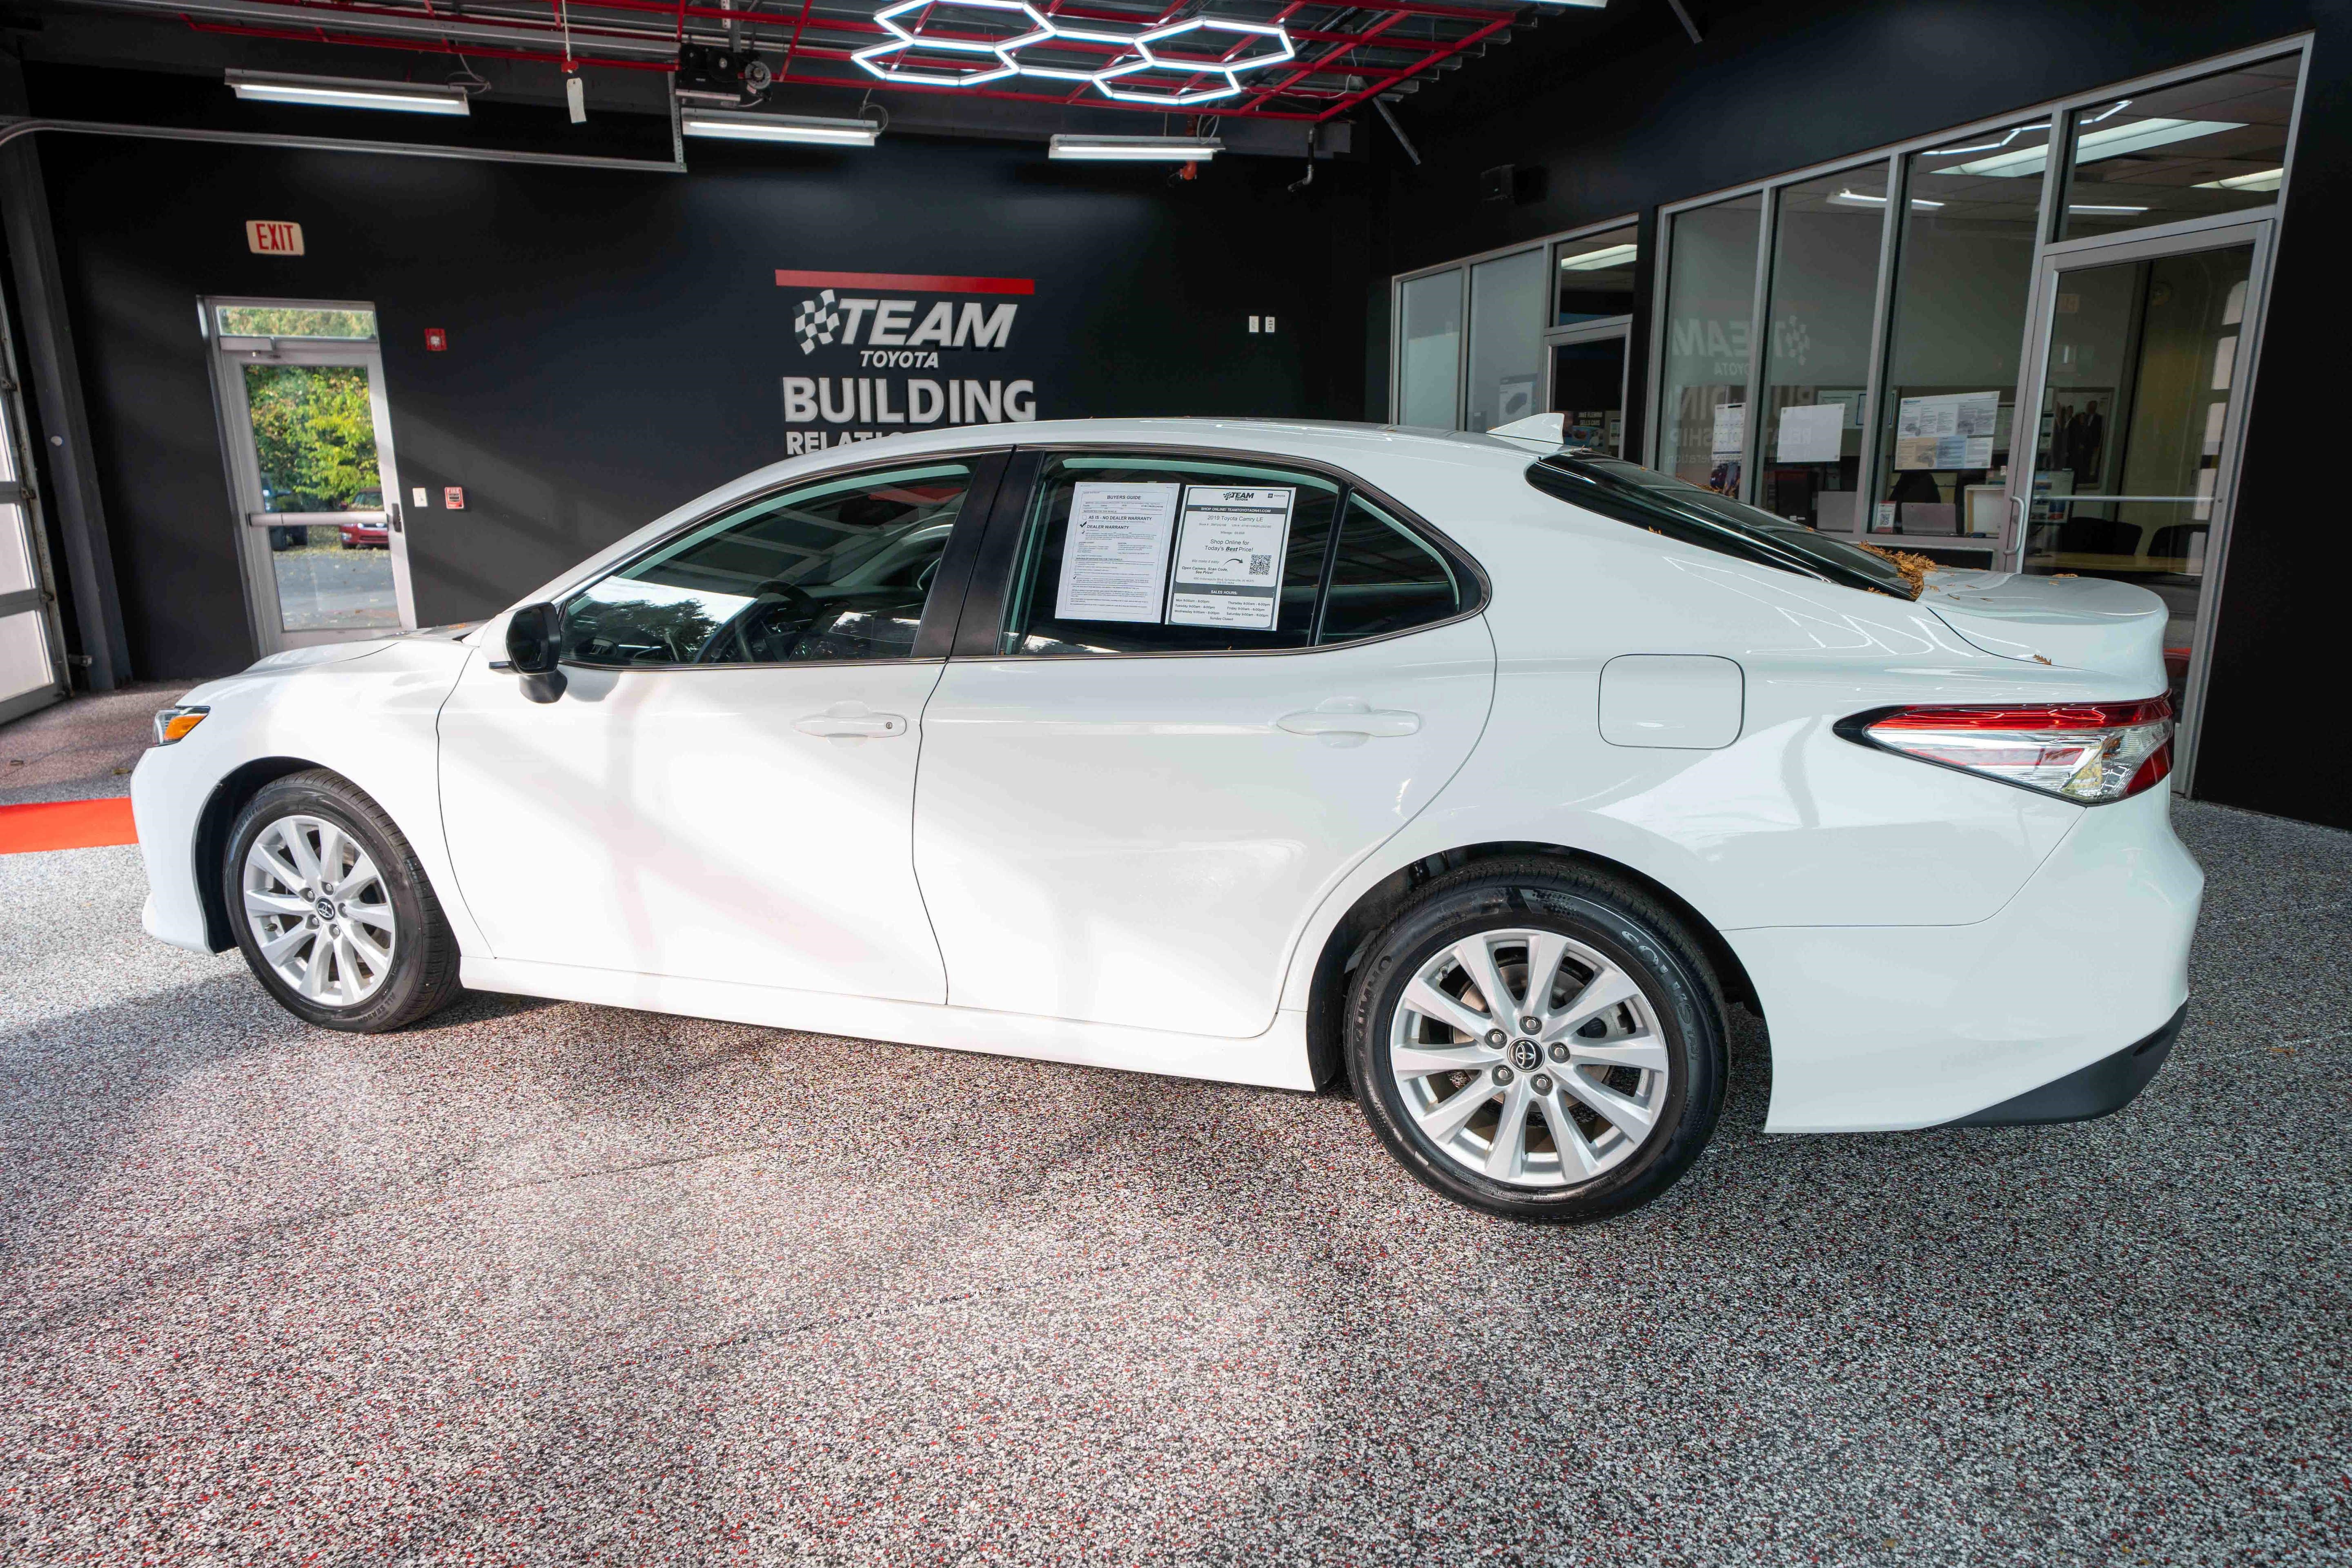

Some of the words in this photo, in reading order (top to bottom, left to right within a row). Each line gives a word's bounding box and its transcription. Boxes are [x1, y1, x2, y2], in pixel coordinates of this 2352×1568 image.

[256, 223, 294, 251] EXIT
[838, 298, 1018, 348] TEAM
[860, 350, 939, 368] TOYOTA
[782, 377, 1036, 423] BUILDING
